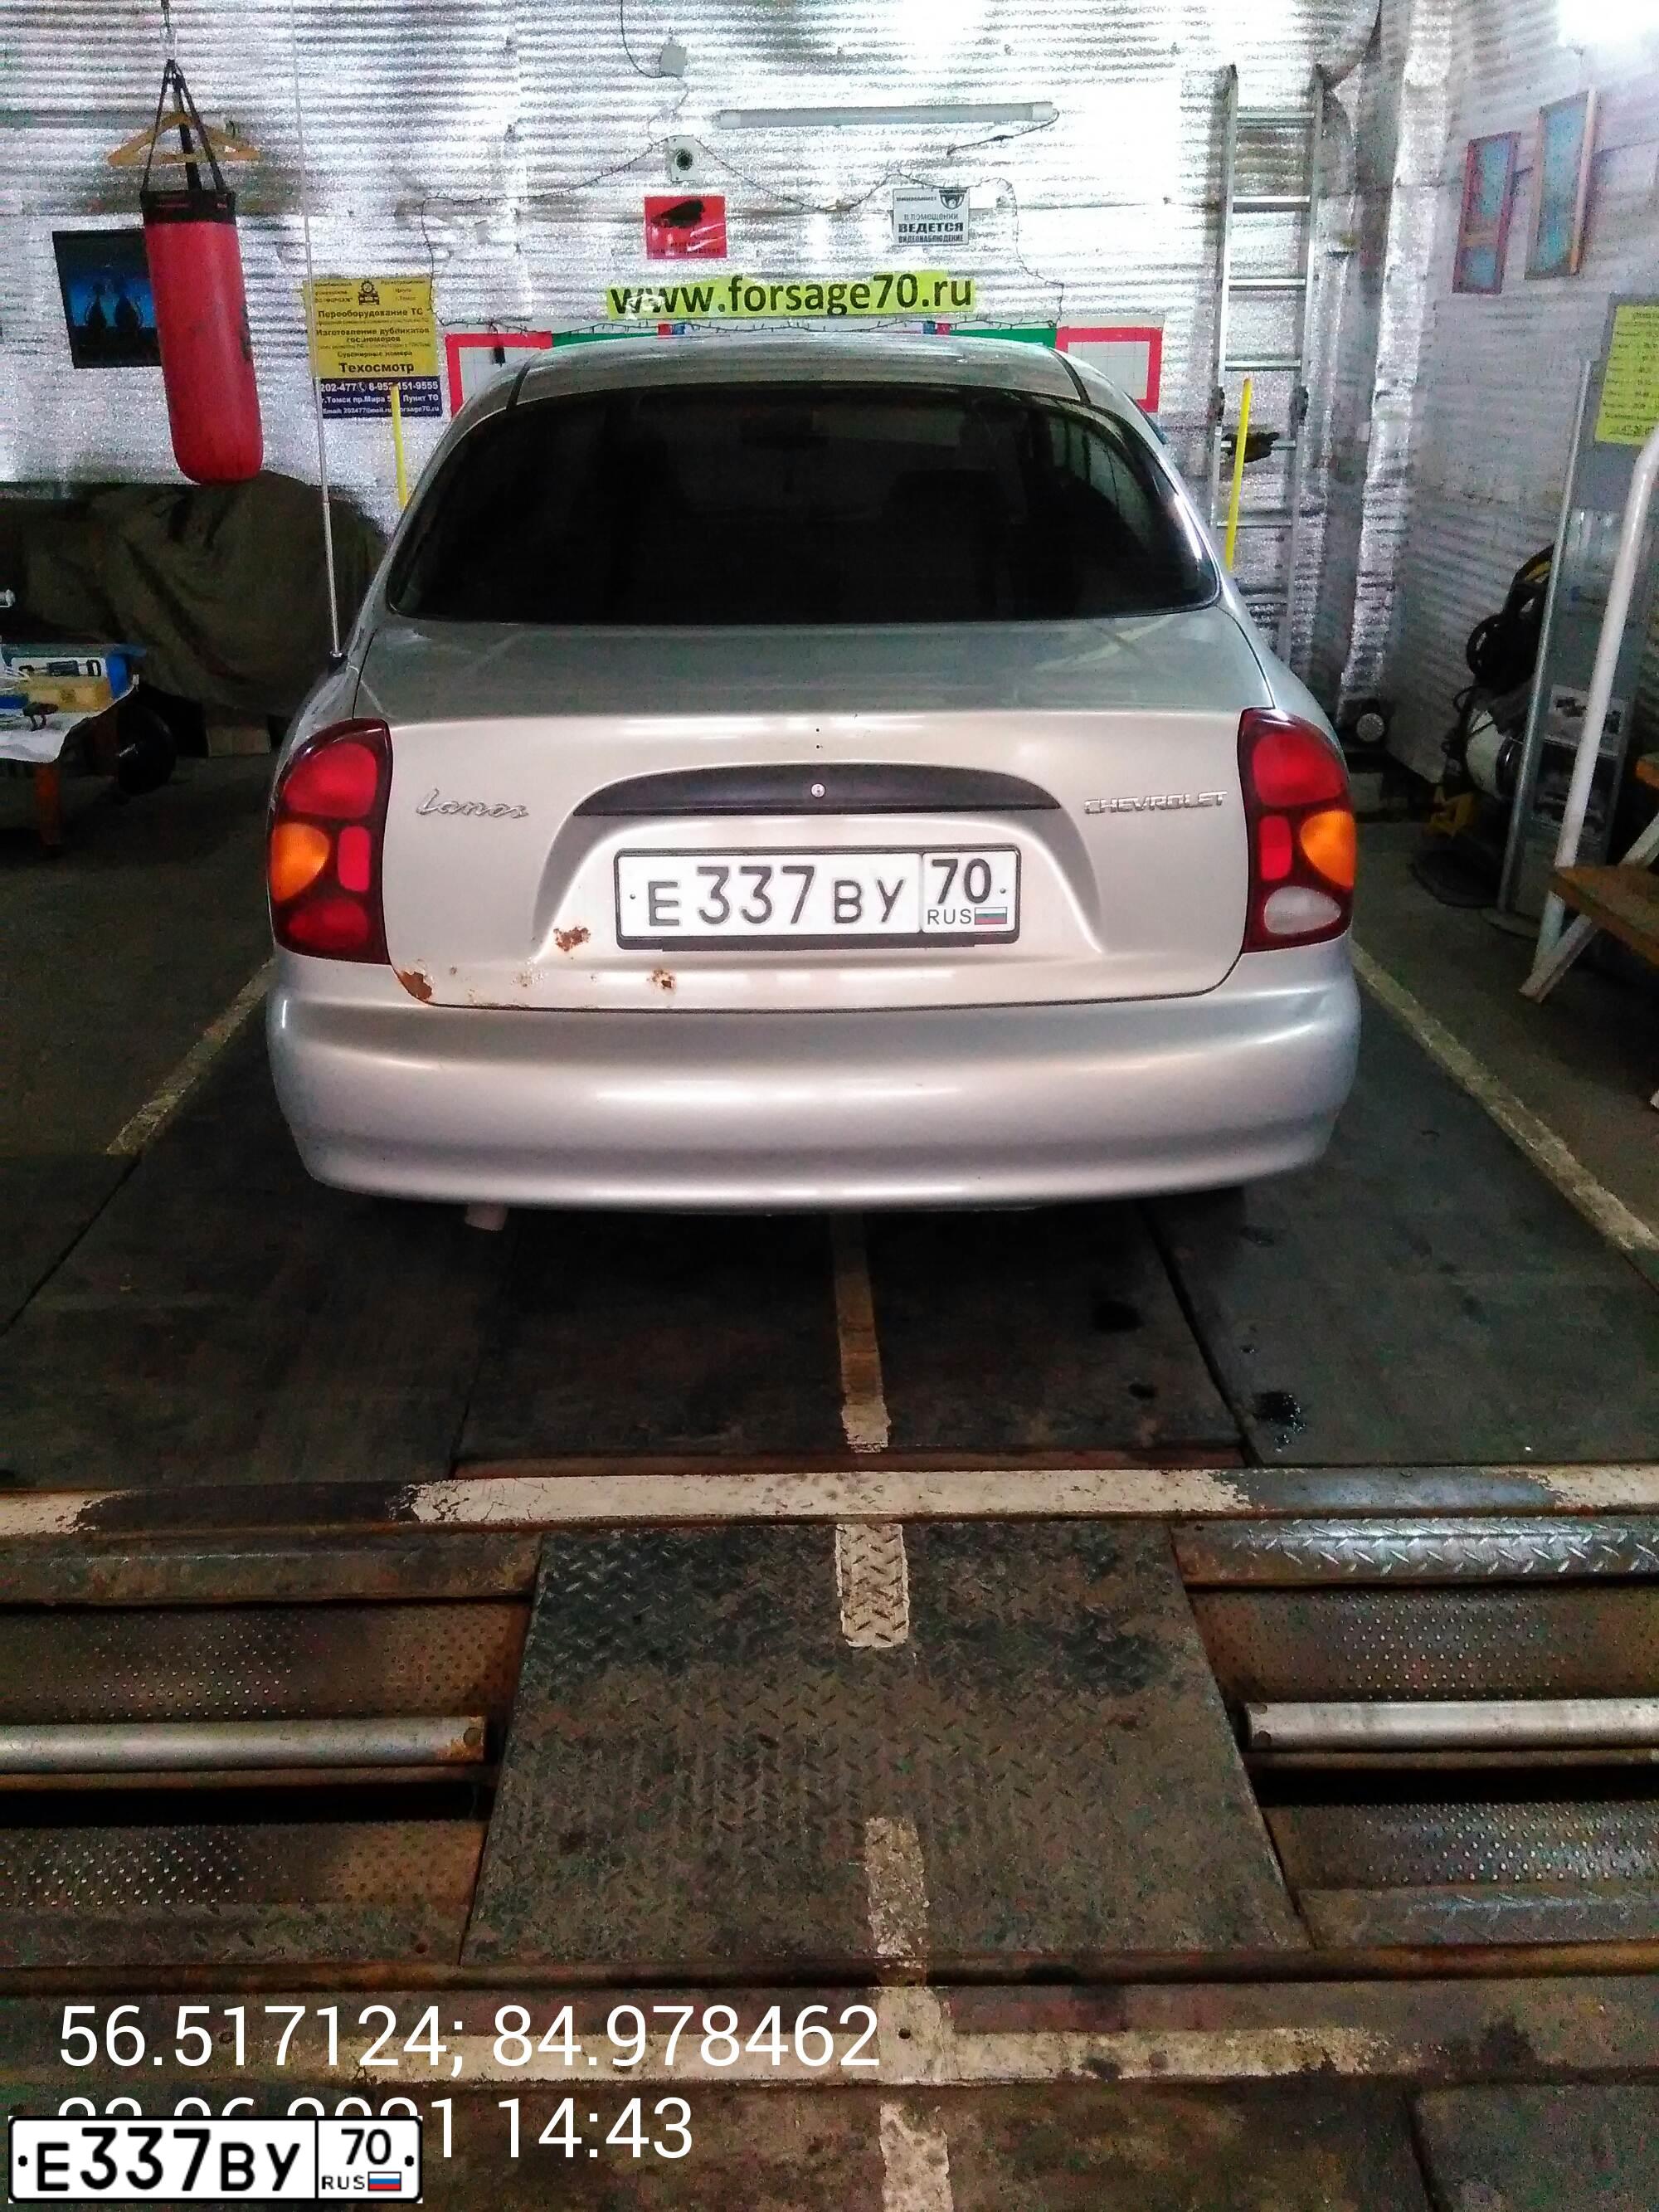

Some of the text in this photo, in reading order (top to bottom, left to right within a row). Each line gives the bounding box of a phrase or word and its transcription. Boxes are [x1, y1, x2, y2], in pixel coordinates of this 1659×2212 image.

[898, 222, 964, 233] ВЕДЕТСЯ
[898, 235, 964, 243] ВИДЕОНАБЛЮДЕНИЕ
[611, 274, 972, 314] www.forsage70.ru
[318, 309, 408, 318] Переоборудование
[338, 363, 415, 373] Техосмотр
[403, 395, 426, 403] Пункт
[416, 788, 529, 819] Lanos
[1084, 791, 1228, 814] CHEVROLET
[932, 859, 992, 904] 70
[927, 909, 972, 925] RUS
